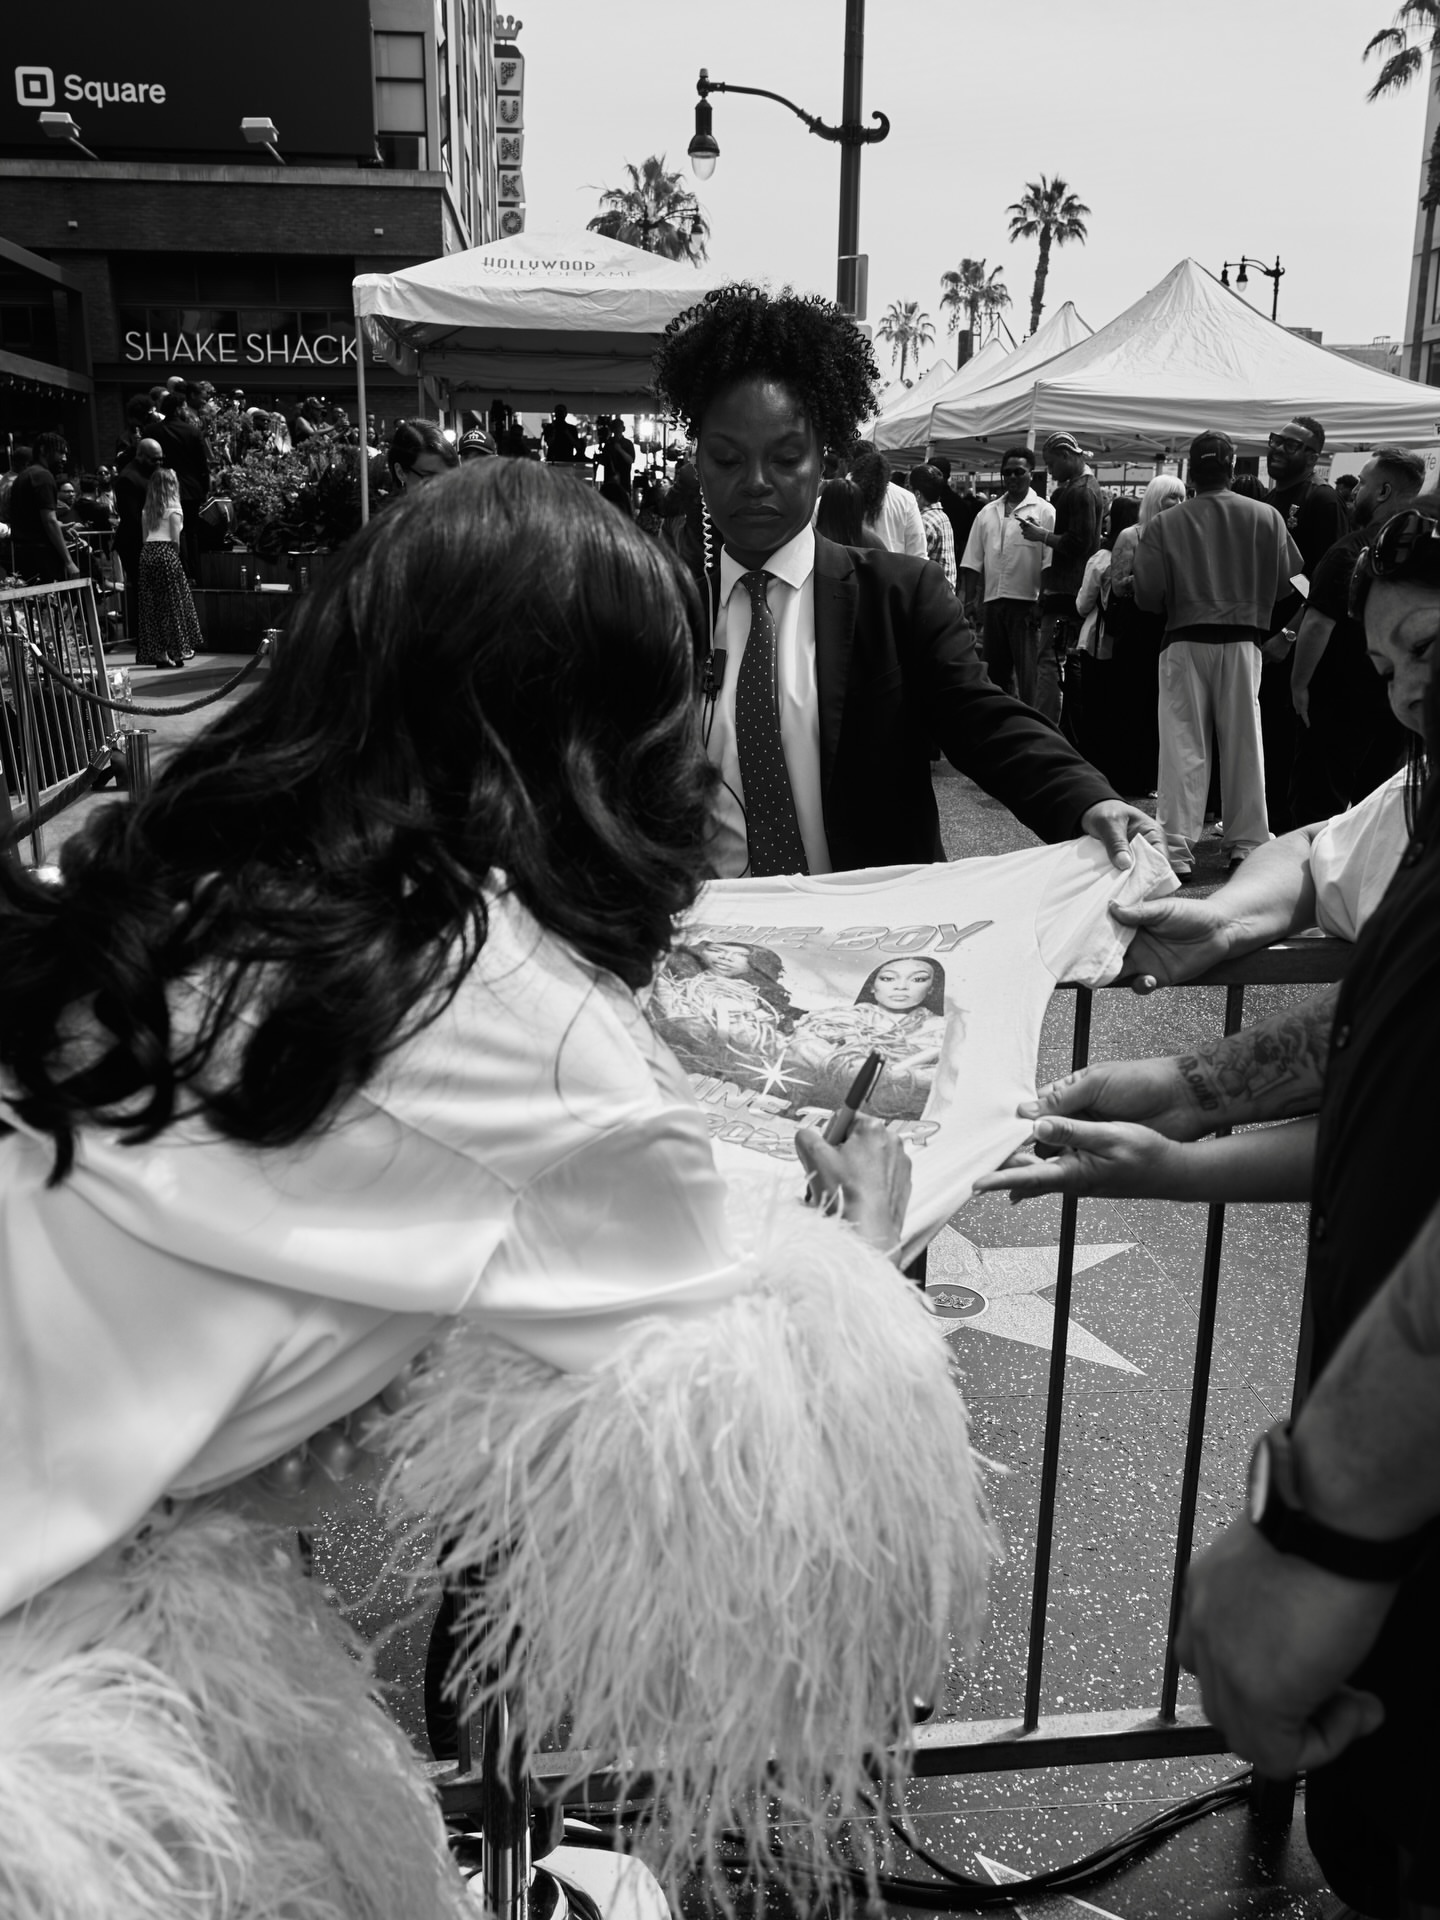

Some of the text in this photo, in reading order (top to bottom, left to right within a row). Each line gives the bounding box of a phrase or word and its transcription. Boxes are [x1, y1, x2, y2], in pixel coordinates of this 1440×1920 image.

[63, 73, 167, 109] Square
[500, 61, 523, 235] FUNKO
[482, 256, 596, 271] HOLLYWOOD
[125, 331, 358, 364] SHAKE SHACK
[827, 919, 995, 953] BOY
